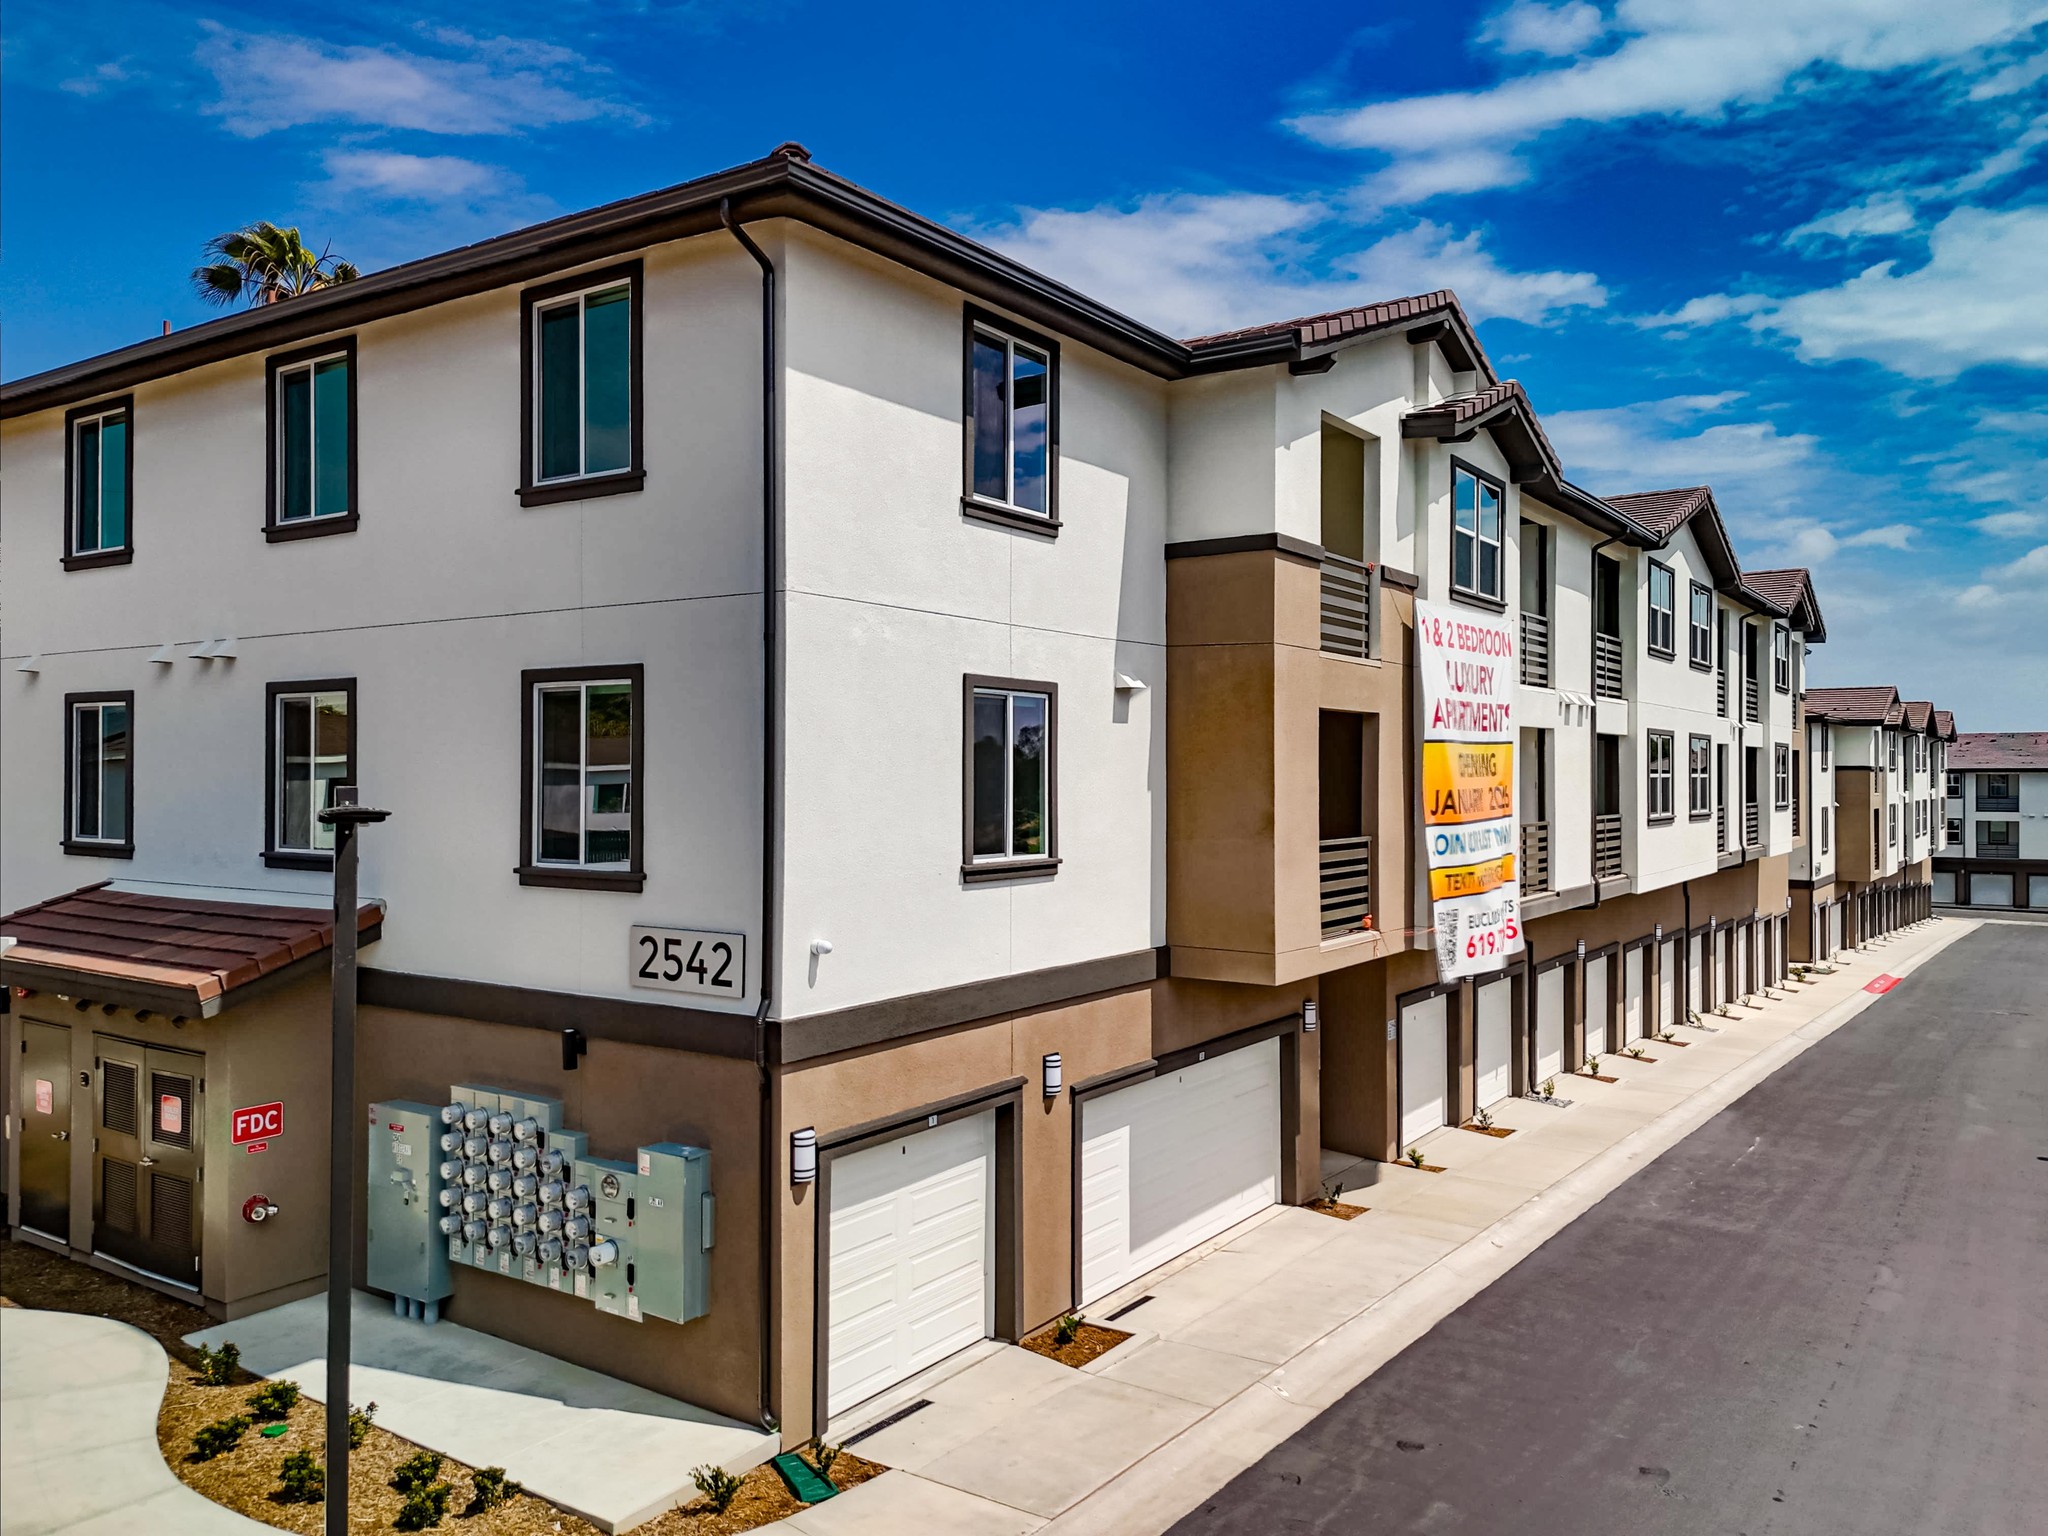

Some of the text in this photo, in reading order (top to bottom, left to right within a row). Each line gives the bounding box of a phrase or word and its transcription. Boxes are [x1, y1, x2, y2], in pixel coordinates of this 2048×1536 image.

[1433, 617, 1443, 647] &
[1446, 620, 1455, 649] 2
[638, 935, 733, 988] 2542
[236, 1110, 278, 1136] FDC
